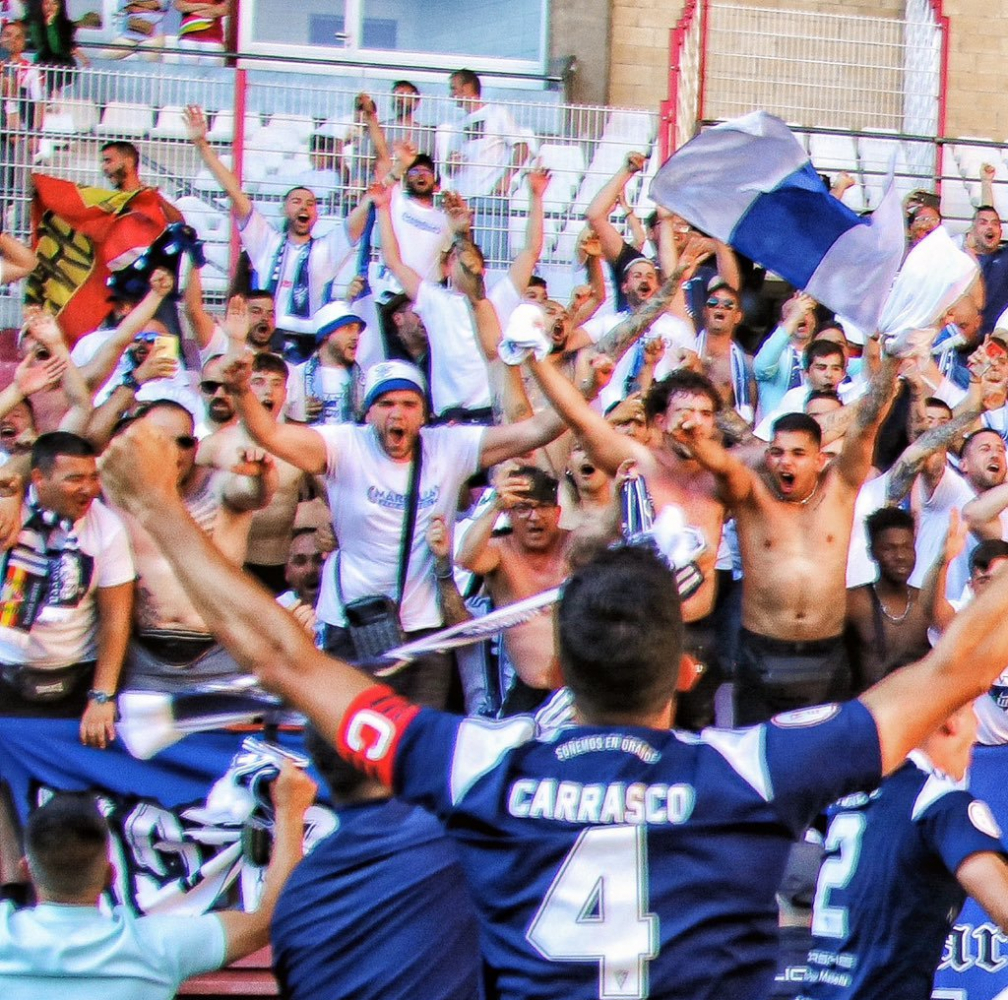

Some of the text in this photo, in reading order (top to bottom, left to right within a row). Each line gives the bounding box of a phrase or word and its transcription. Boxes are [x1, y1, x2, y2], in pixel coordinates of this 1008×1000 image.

[555, 735, 604, 761] SOÑEMOS
[604, 734, 619, 749] EN
[508, 778, 696, 825] CARRASCO
[525, 823, 661, 1000] 4
[811, 811, 866, 938] 2
